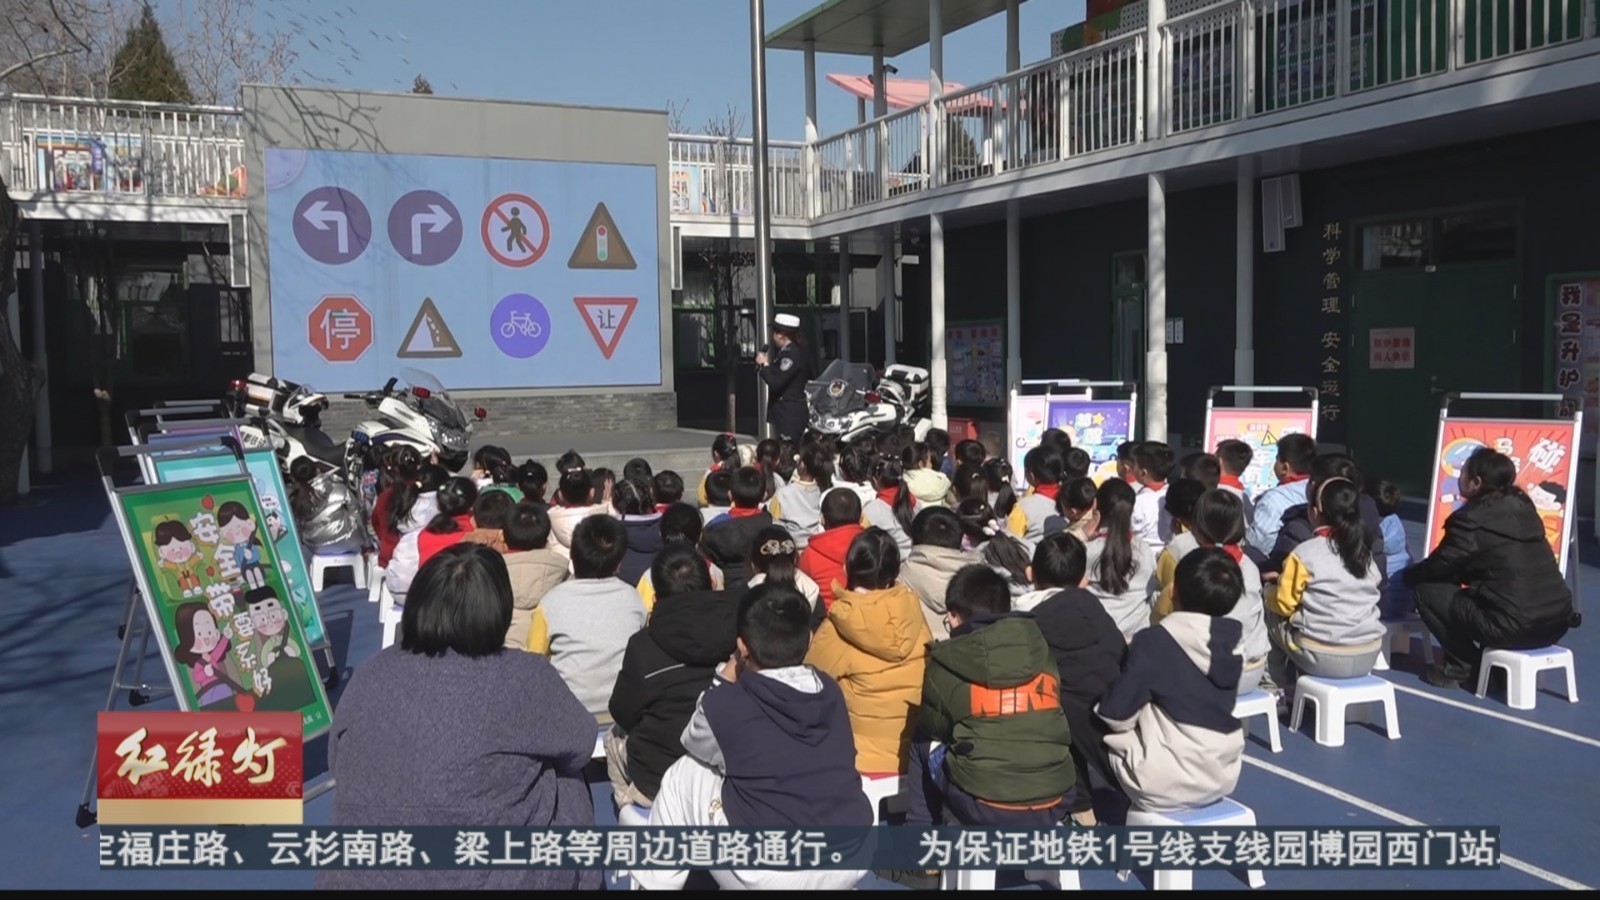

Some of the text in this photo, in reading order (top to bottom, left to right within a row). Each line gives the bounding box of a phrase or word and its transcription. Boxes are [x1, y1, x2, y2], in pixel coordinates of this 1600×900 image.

[320, 308, 361, 350] 停
[597, 309, 617, 329] 让
[1321, 222, 1342, 421] 科学管理 安全运行
